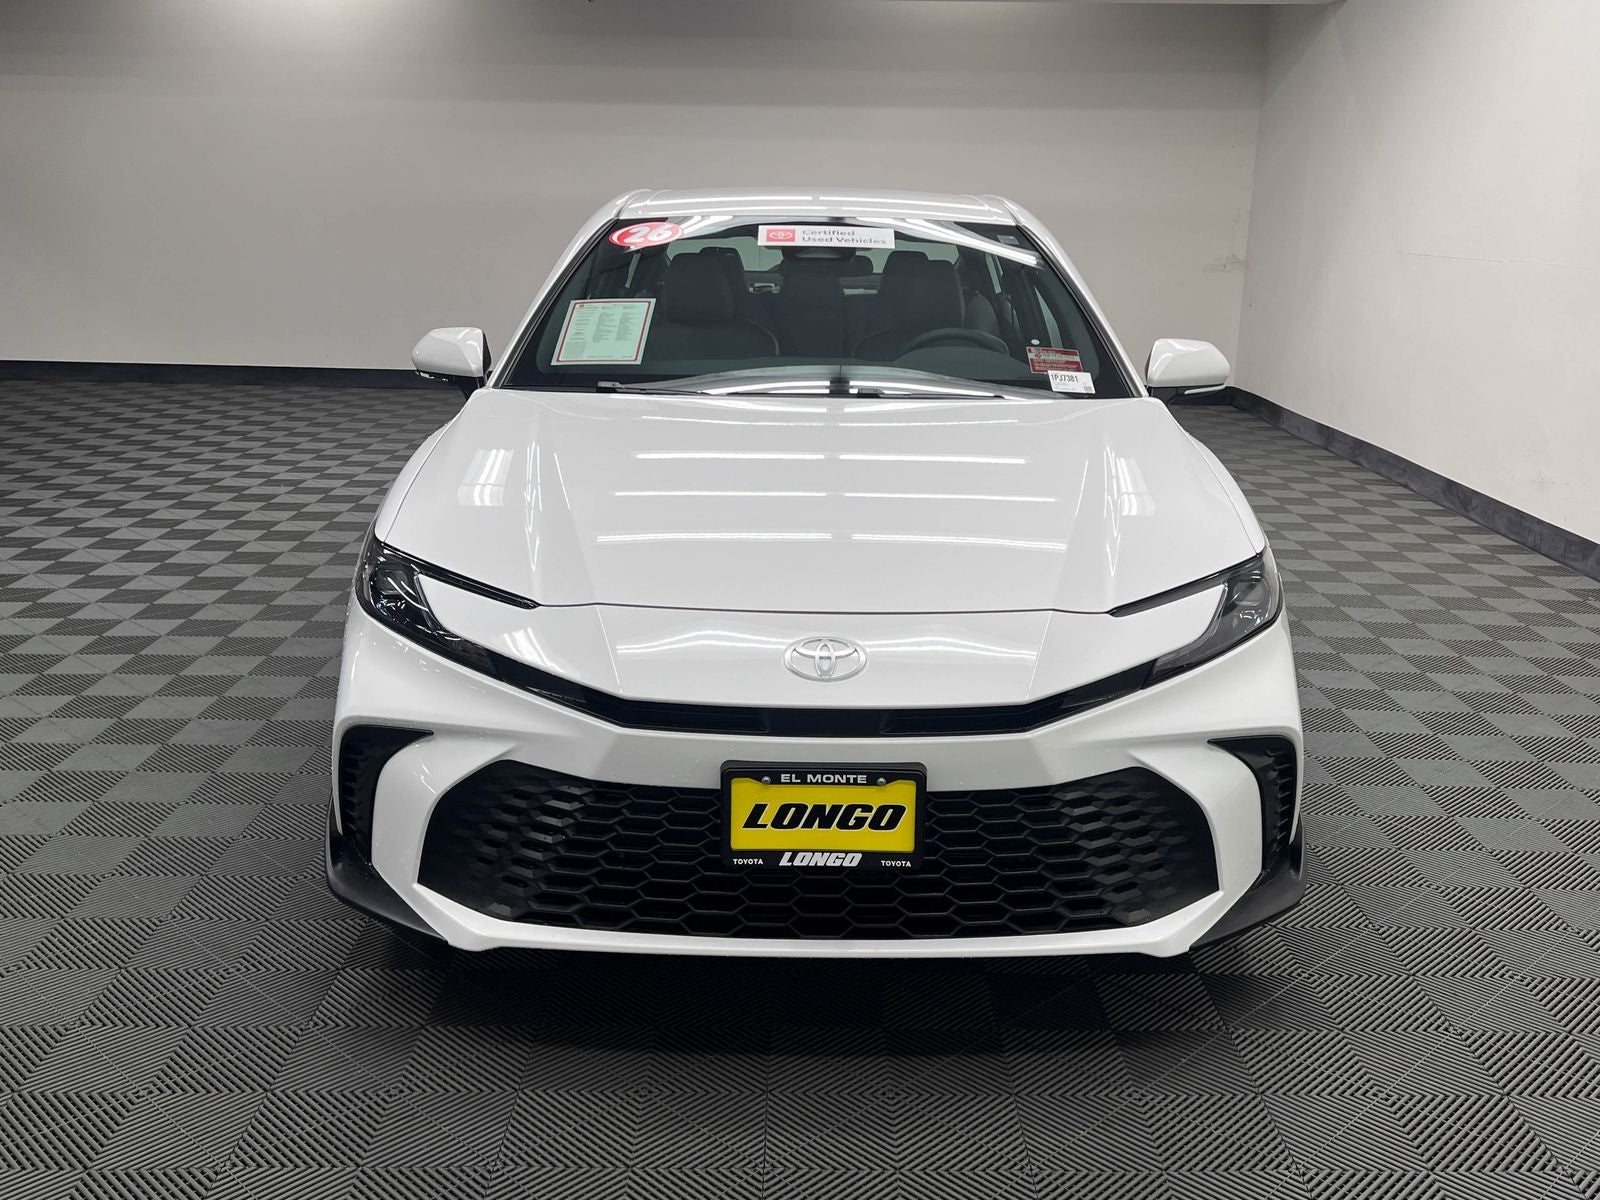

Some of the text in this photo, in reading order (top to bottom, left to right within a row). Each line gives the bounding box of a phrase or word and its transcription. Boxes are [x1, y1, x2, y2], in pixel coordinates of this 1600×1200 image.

[623, 224, 674, 243] 26
[836, 237, 887, 245] Vehicles
[1050, 373, 1079, 383] 1PJ7381
[780, 773, 868, 784] EL MONTE
[742, 802, 907, 832] LONGO
[779, 851, 863, 867] LONGO
